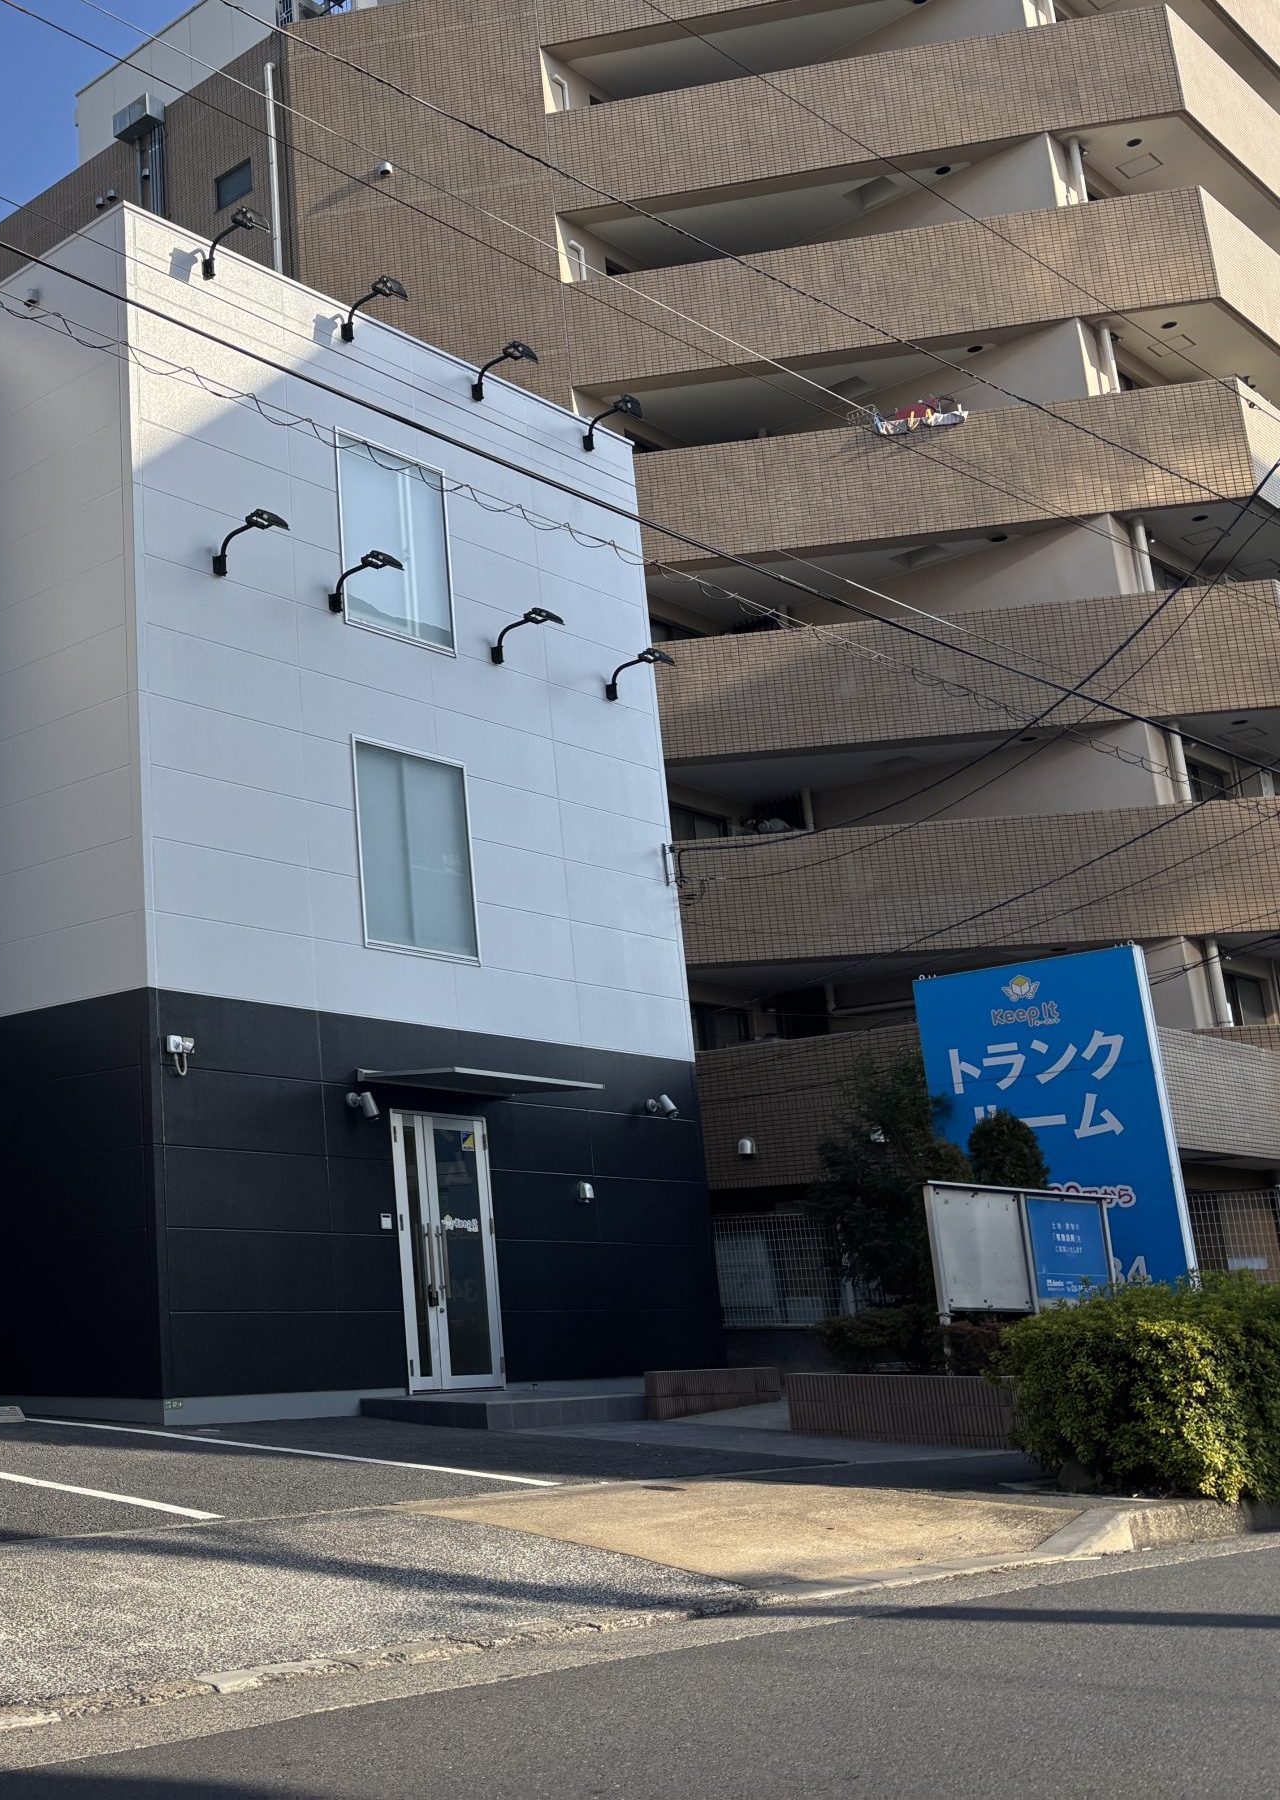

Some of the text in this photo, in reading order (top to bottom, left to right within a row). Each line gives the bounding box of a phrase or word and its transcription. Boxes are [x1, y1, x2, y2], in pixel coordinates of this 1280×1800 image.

[991, 1006, 1040, 1027] Keep
[1042, 1001, 1060, 1018] It
[949, 1029, 1125, 1095] トランク
[974, 1093, 1125, 1140] ーム
